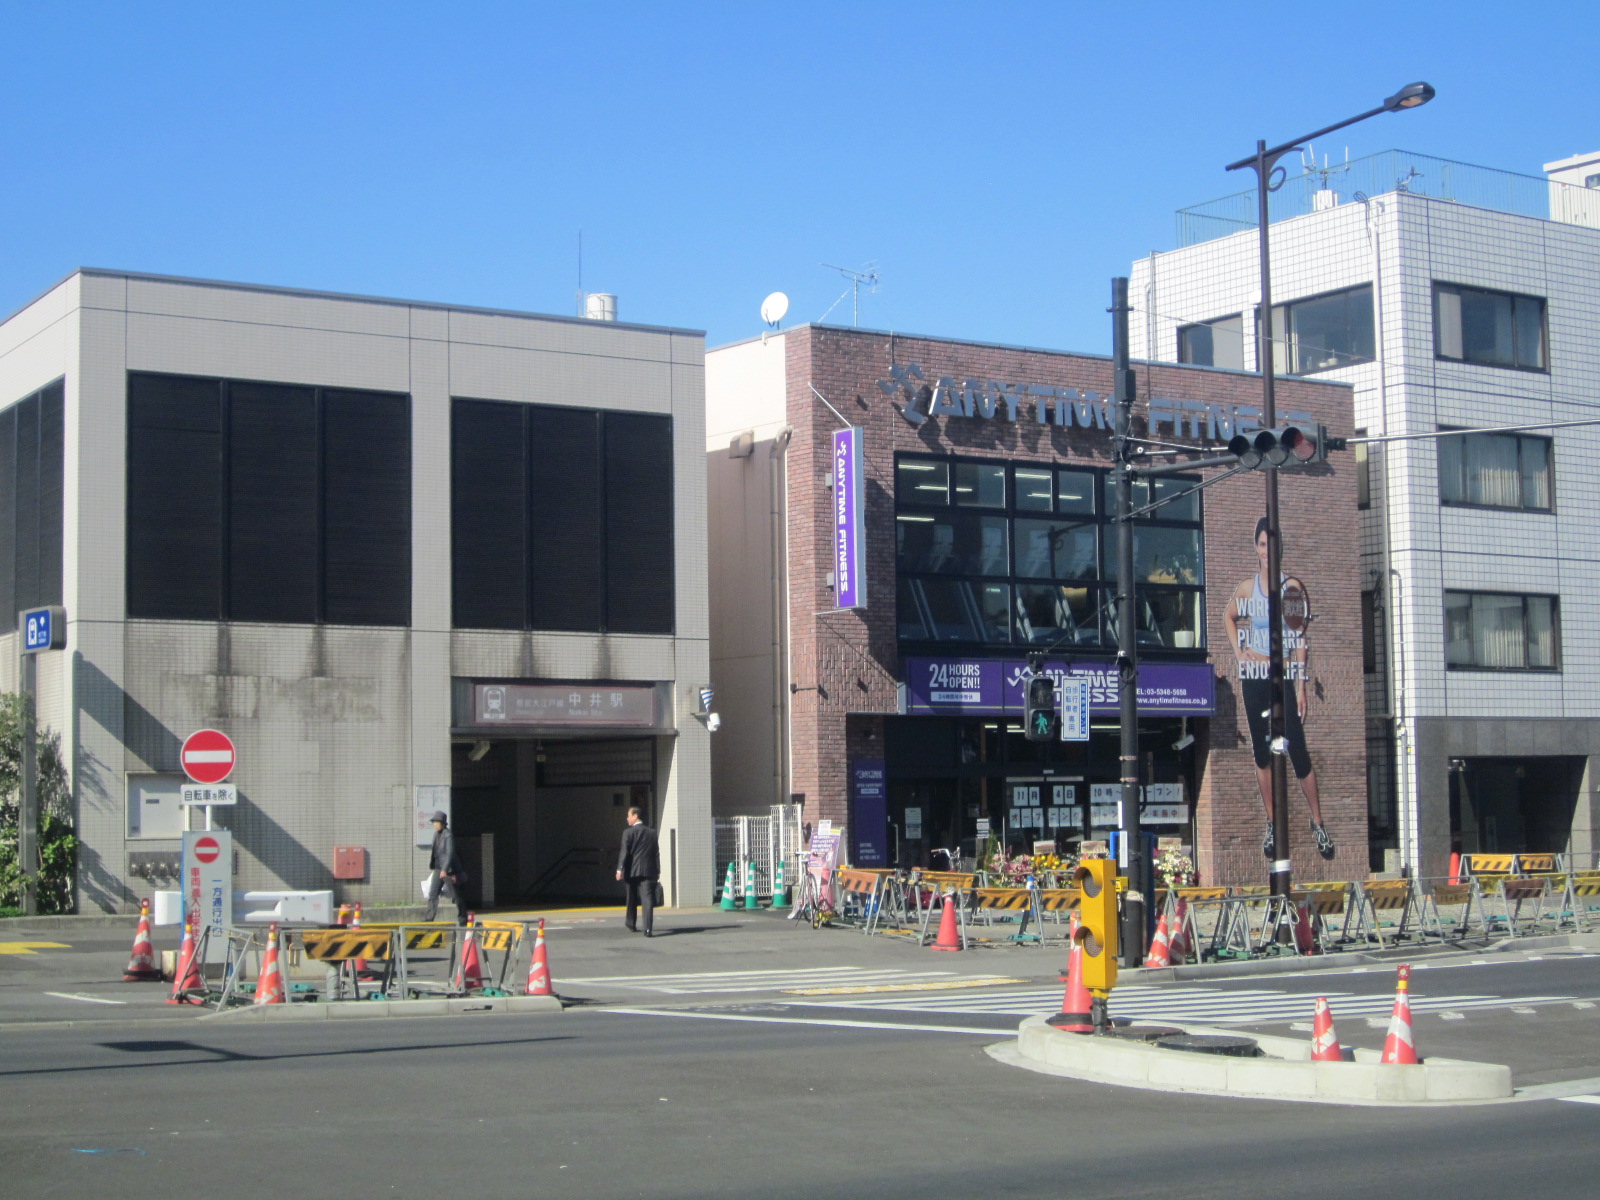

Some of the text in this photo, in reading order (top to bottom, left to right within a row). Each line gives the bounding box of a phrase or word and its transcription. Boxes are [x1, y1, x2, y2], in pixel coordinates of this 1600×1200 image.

[837, 458, 846, 525] ANYTIME
[1281, 630, 1308, 649] ARD.
[929, 664, 948, 688] 24
[949, 664, 980, 676] HOURS
[1283, 661, 1309, 680] IFE.
[949, 677, 980, 689] OPEN!!
[569, 692, 623, 708] 中井駅
[184, 790, 233, 801] 自転車を除く
